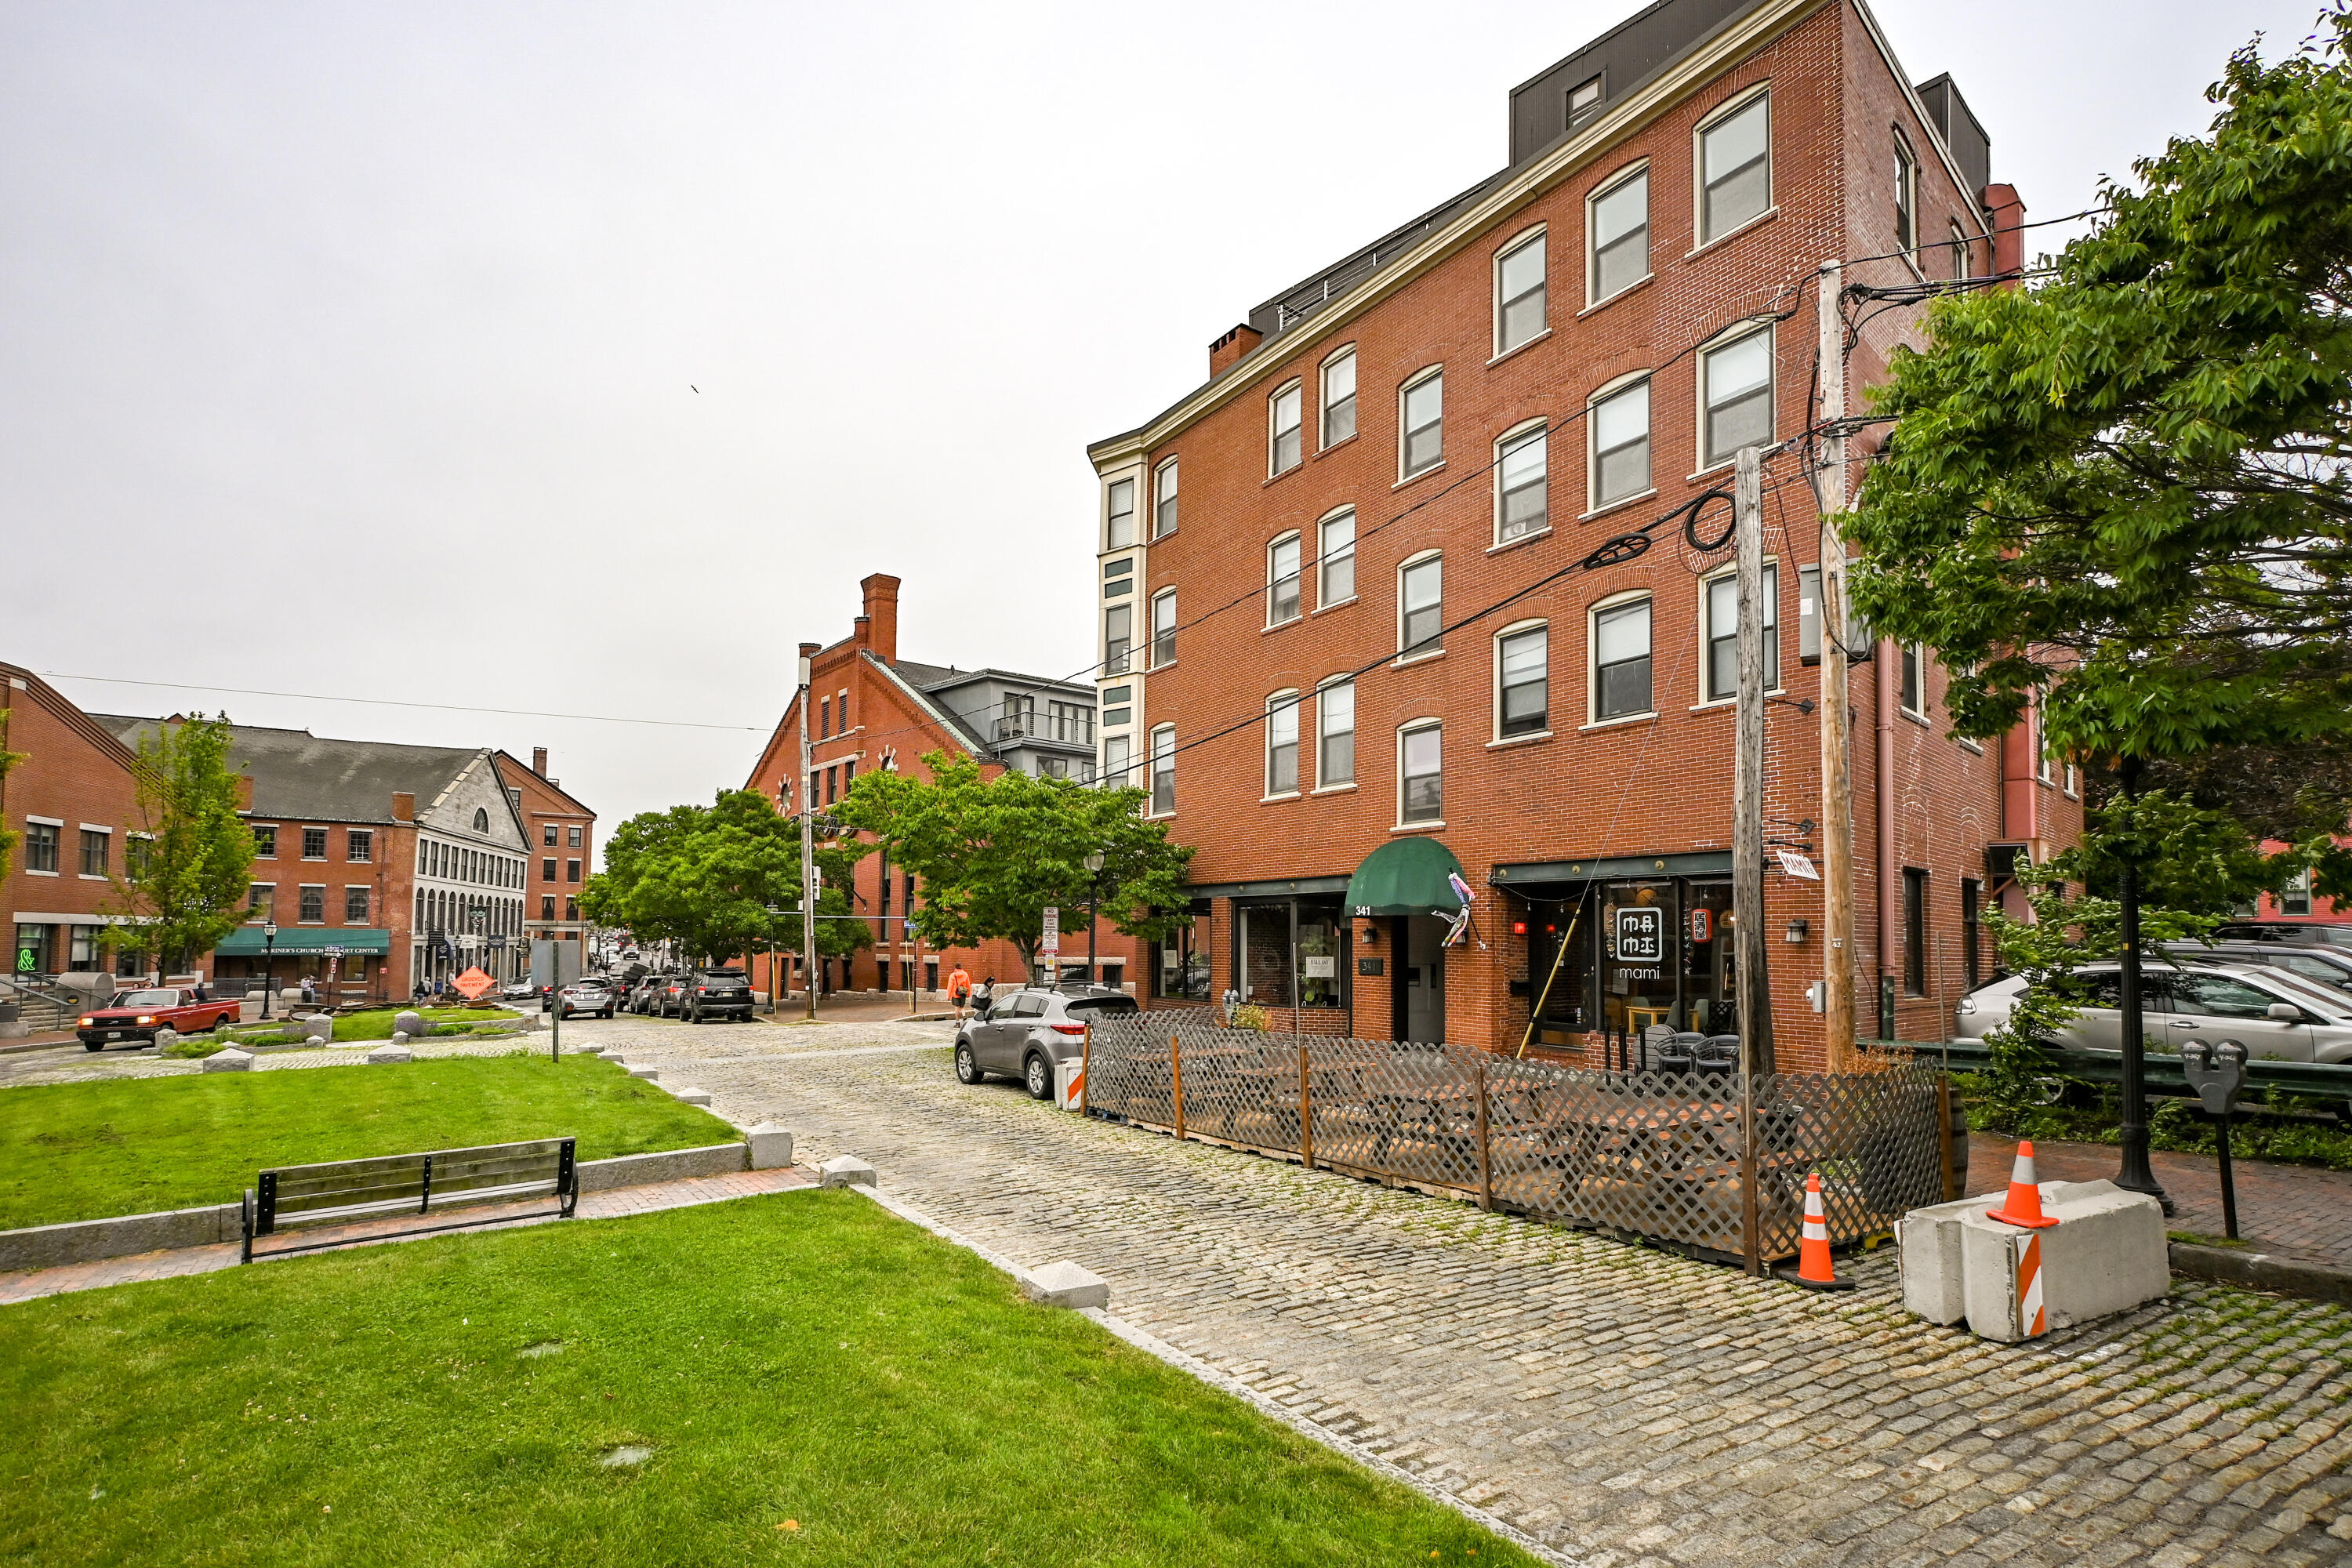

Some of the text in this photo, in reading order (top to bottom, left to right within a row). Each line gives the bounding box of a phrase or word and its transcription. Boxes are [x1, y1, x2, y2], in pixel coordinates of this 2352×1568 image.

[1781, 855, 1810, 873] MAMI
[1356, 906, 1370, 916] 341
[18, 949, 35, 971] &
[1363, 962, 1375, 971] 341
[1619, 966, 1660, 979] mami
